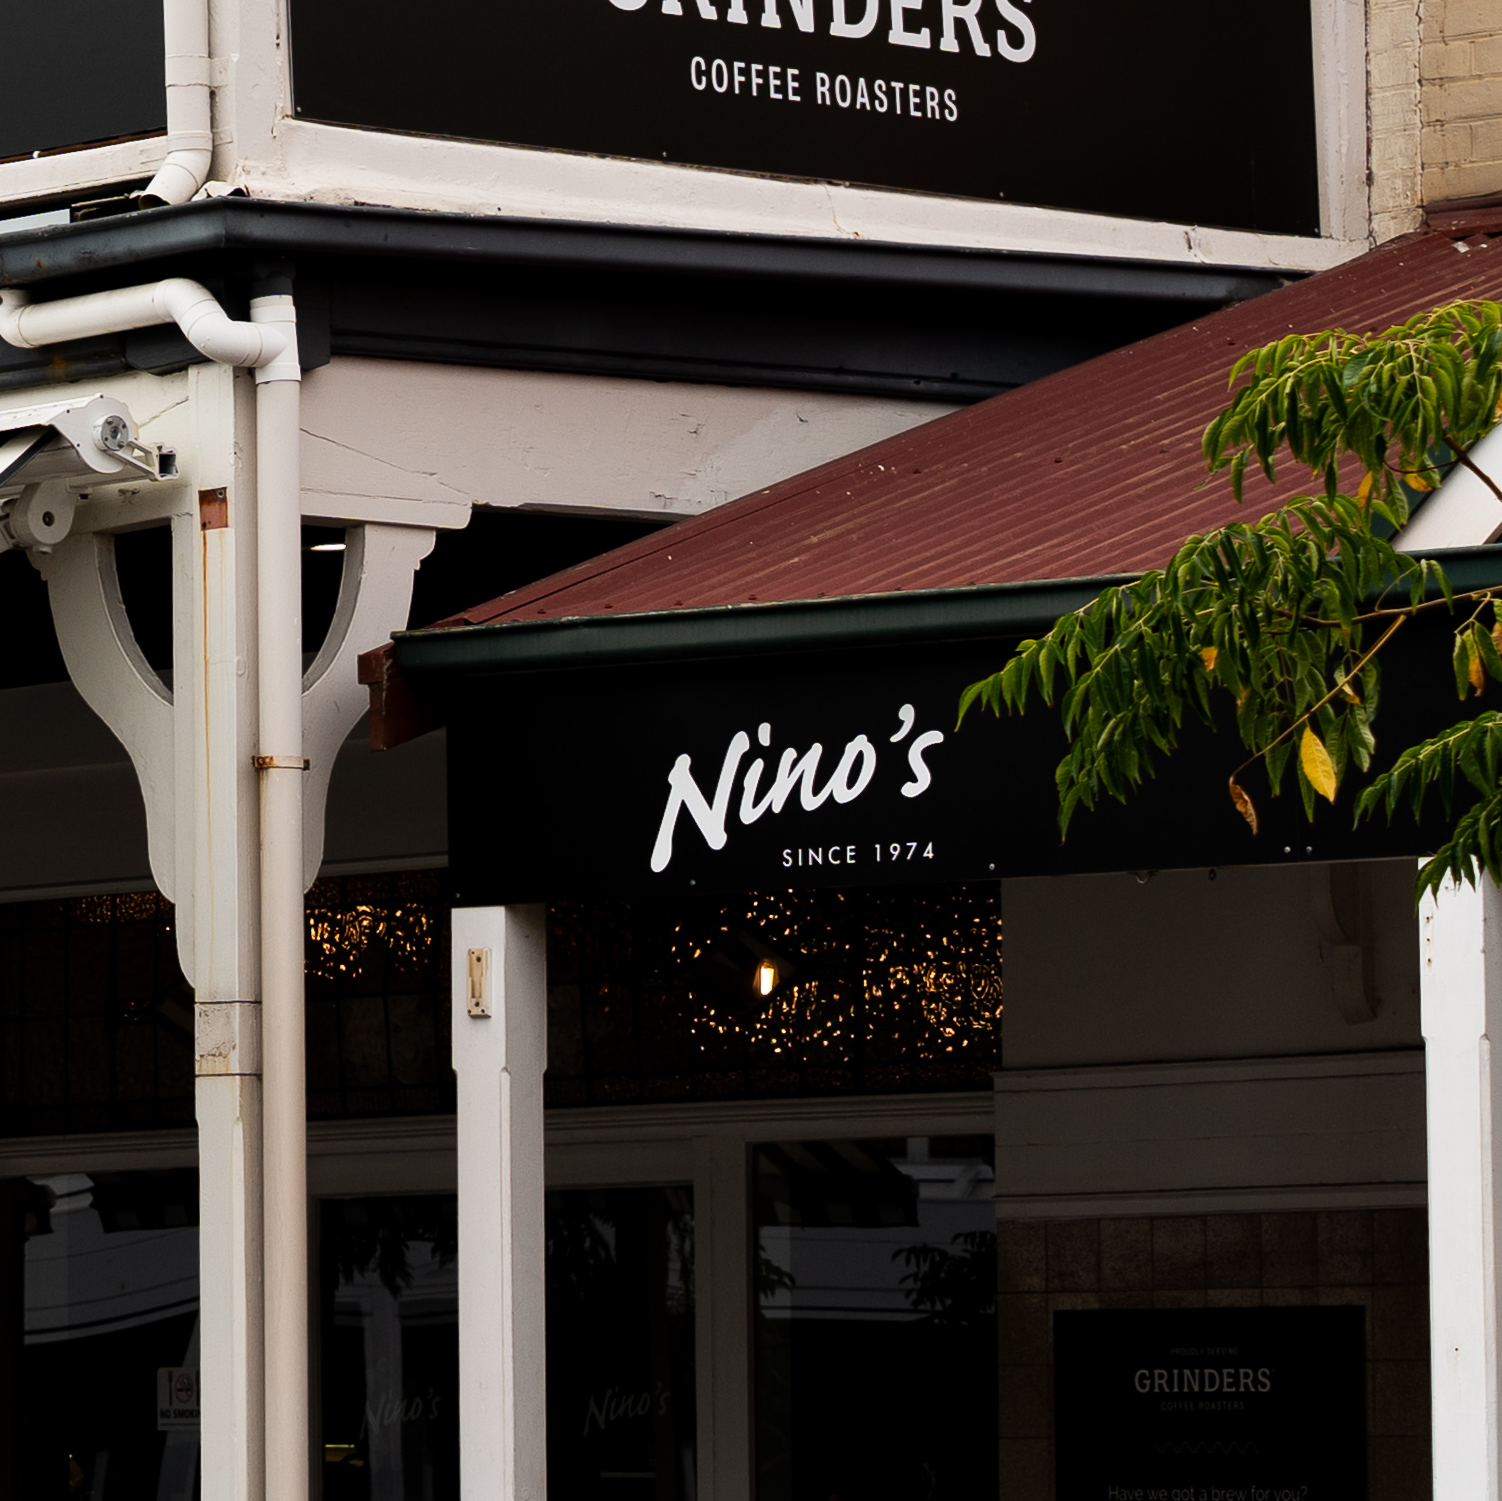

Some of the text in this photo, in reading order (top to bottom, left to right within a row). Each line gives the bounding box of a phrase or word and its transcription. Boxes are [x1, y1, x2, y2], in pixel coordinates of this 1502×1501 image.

[690, 55, 959, 122] COFFEE ROASTERS
[650, 703, 944, 872] Nino's
[782, 841, 934, 867] SINCE 1974
[159, 1409, 172, 1419] NO
[359, 1386, 443, 1442] Nino's
[582, 1380, 672, 1438] Nino's
[1160, 1400, 1245, 1411] COFFEE ROASTERS
[1107, 1486, 1145, 1501] Have
[1146, 1489, 1168, 1501] we
[1199, 1490, 1208, 1501] a
[1211, 1486, 1247, 1501] brew
[1250, 1486, 1272, 1501] for
